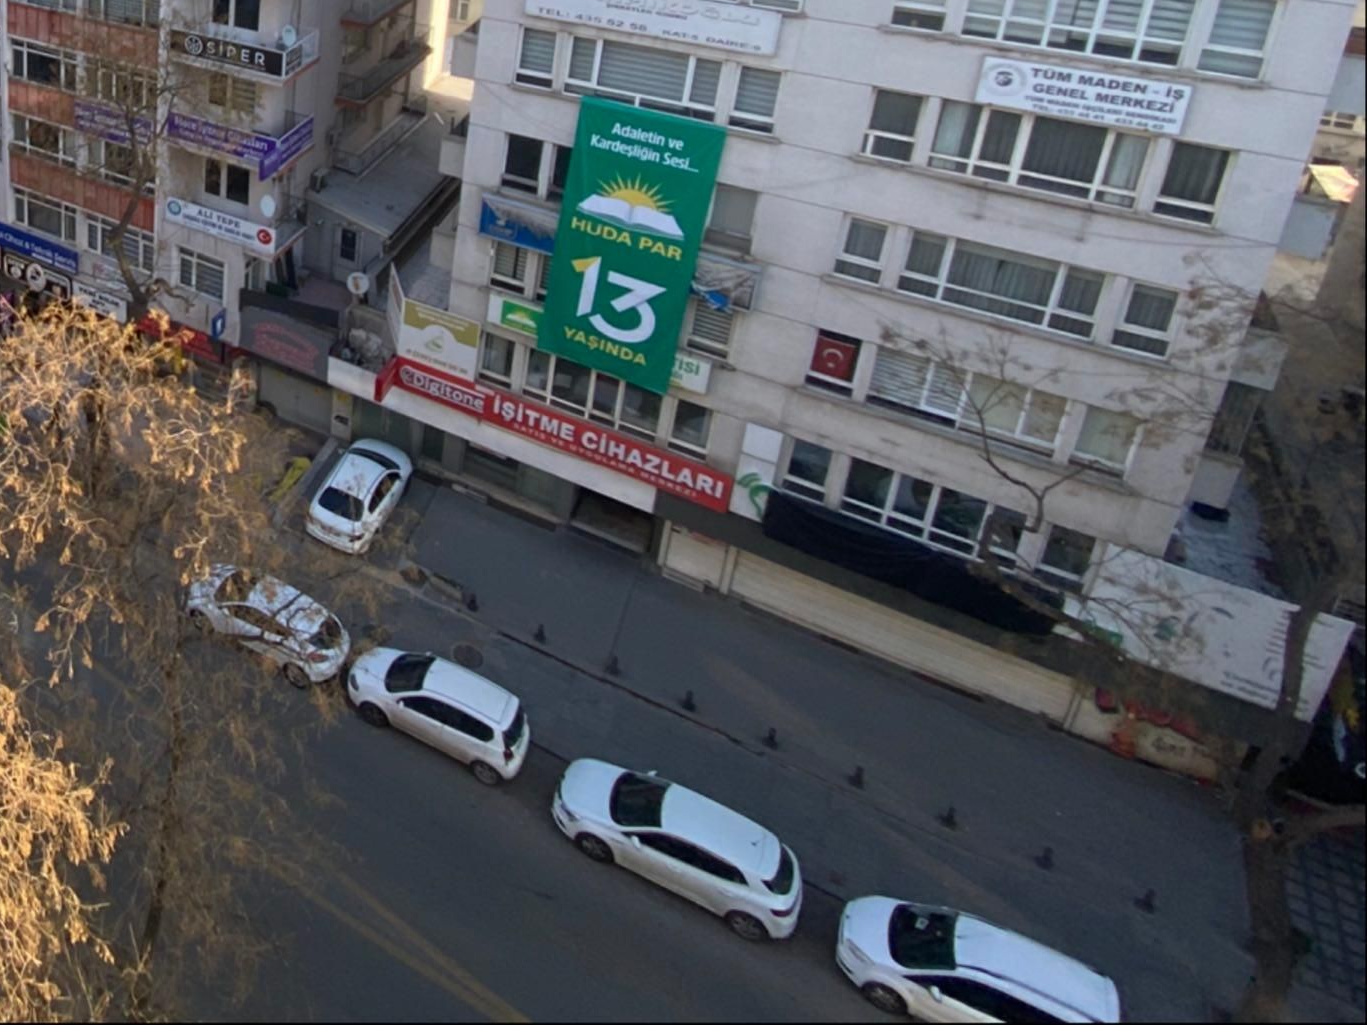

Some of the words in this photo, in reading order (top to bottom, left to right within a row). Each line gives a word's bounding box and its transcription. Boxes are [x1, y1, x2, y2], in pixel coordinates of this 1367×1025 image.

[206, 40, 267, 66] SİPER
[1031, 67, 1072, 84] TÜM
[1077, 75, 1148, 94] MADEN
[1165, 84, 1186, 102] İŞ
[1032, 82, 1089, 101] GENEL
[1094, 91, 1175, 114] MERKEZİ
[590, 134, 661, 163] Kardeşliğin
[611, 122, 665, 147] Adaletin
[668, 138, 684, 151] ve
[638, 237, 683, 262] PAR
[570, 256, 668, 344] 13
[564, 325, 647, 366] YAŞINDA
[412, 373, 484, 411] Digitone
[492, 394, 575, 443] İŞİTME
[580, 430, 726, 499] CİHAZLARI
